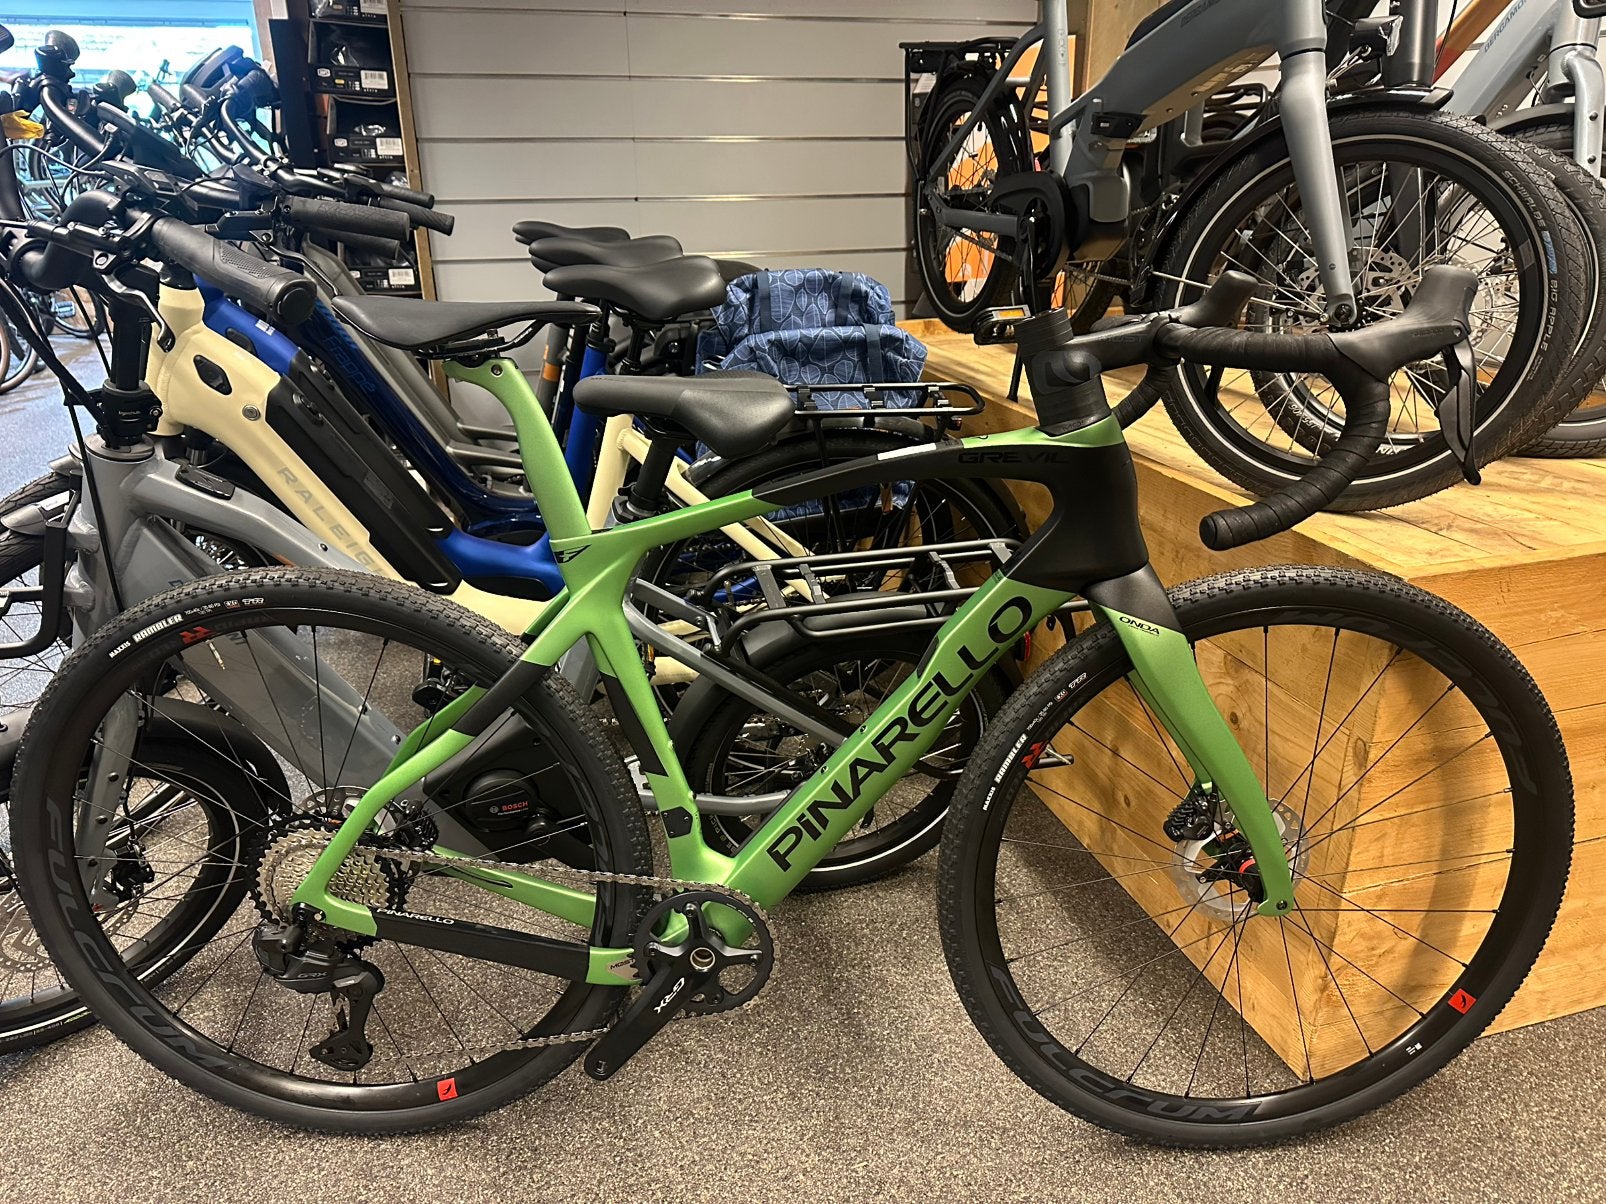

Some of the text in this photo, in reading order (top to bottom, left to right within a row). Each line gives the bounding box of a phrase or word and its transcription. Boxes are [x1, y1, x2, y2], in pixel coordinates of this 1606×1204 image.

[1484, 0, 1527, 53] BERGAMO
[1501, 170, 1547, 228] SCHWALBE
[1540, 279, 1558, 352] BIG APPLE
[957, 451, 1070, 464] GREVIL
[108, 640, 132, 659] MAXXIS
[131, 613, 184, 644] RAMBLER
[1119, 616, 1160, 635] ONDA
[982, 786, 996, 811] MAXXIS
[993, 733, 1028, 784] RAMBLER
[501, 800, 529, 811] BOSCH
[653, 977, 685, 1014] GRX
[989, 965, 1253, 1121] FULCRUM
